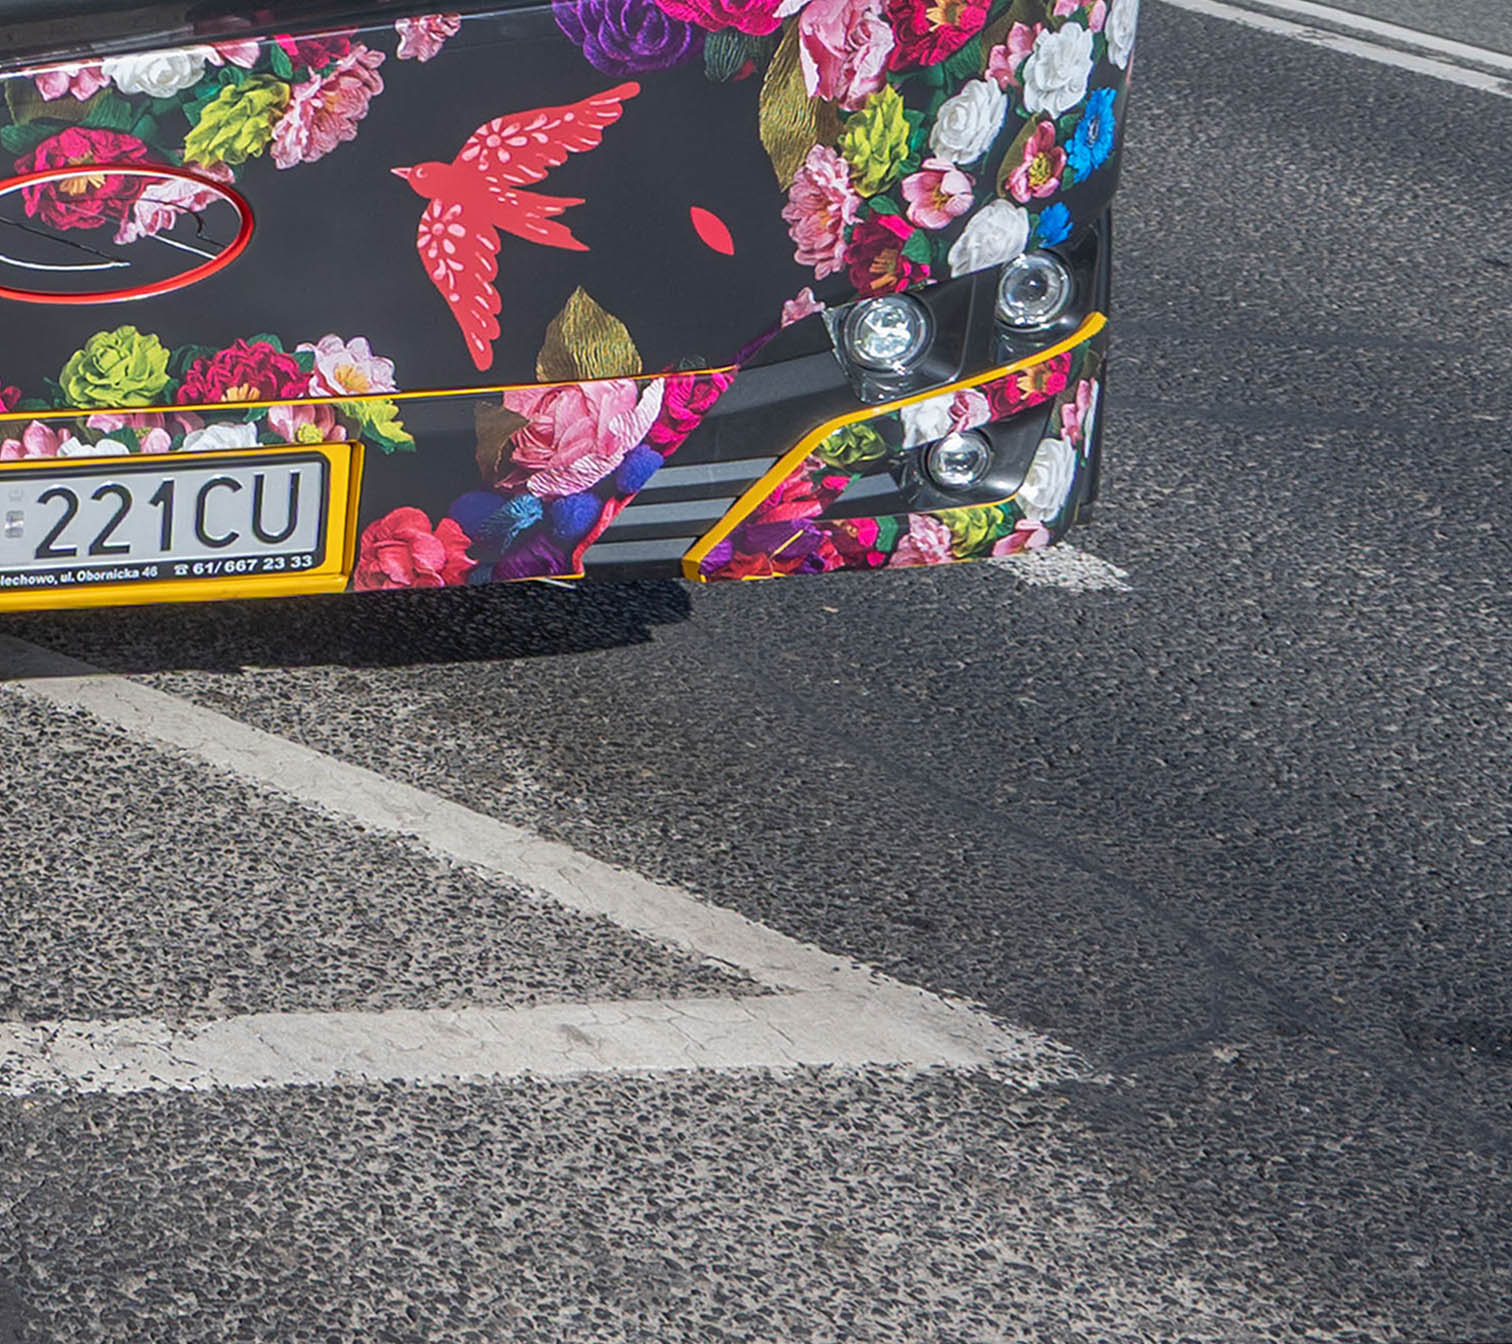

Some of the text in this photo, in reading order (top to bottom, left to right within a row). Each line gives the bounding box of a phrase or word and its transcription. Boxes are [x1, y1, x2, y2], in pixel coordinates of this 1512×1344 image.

[33, 470, 302, 560] 221CU
[60, 571, 75, 583] ul.
[76, 568, 140, 582] Obornicka
[141, 565, 158, 578] 46
[262, 556, 286, 571] 23
[290, 555, 313, 568] 33
